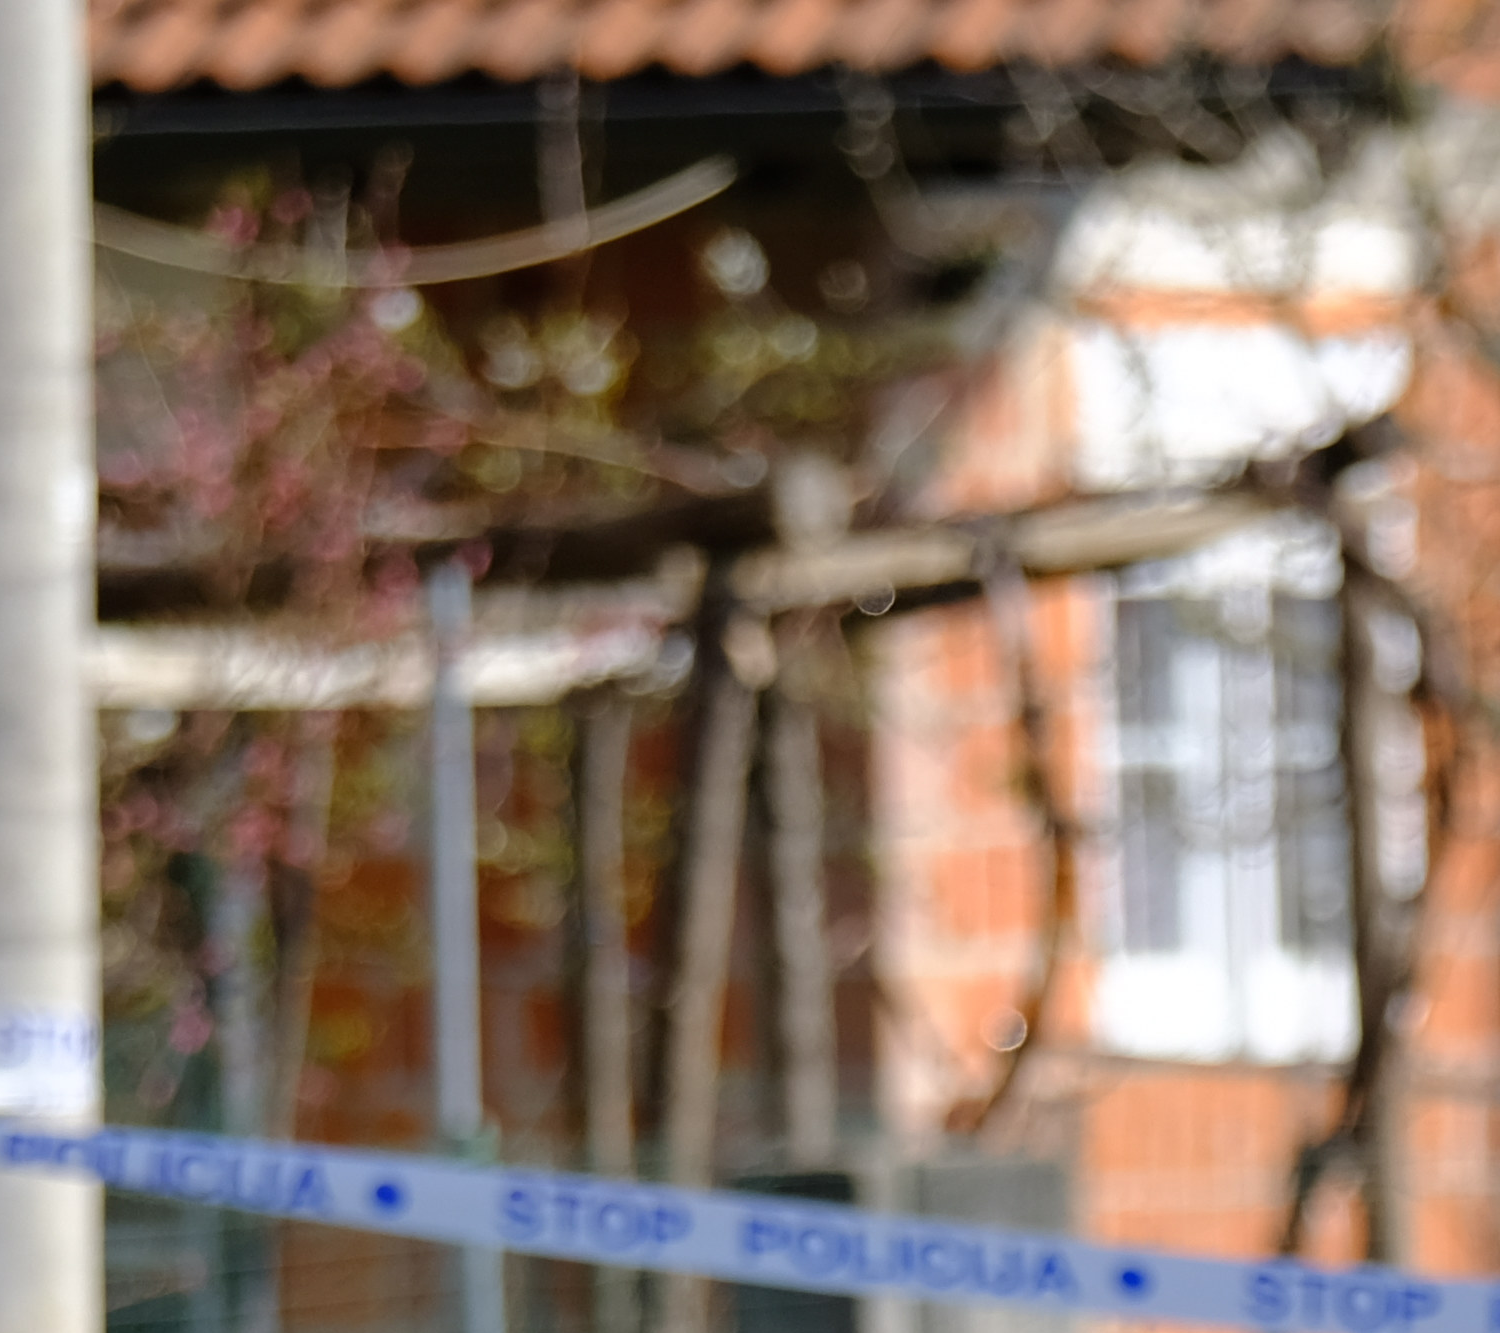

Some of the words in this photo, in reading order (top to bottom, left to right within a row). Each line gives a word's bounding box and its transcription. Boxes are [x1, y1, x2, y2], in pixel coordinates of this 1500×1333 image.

[500, 1184, 693, 1256] STOP
[738, 1212, 1080, 1302] POLICIJA
[1244, 1270, 1442, 1332] STOP
